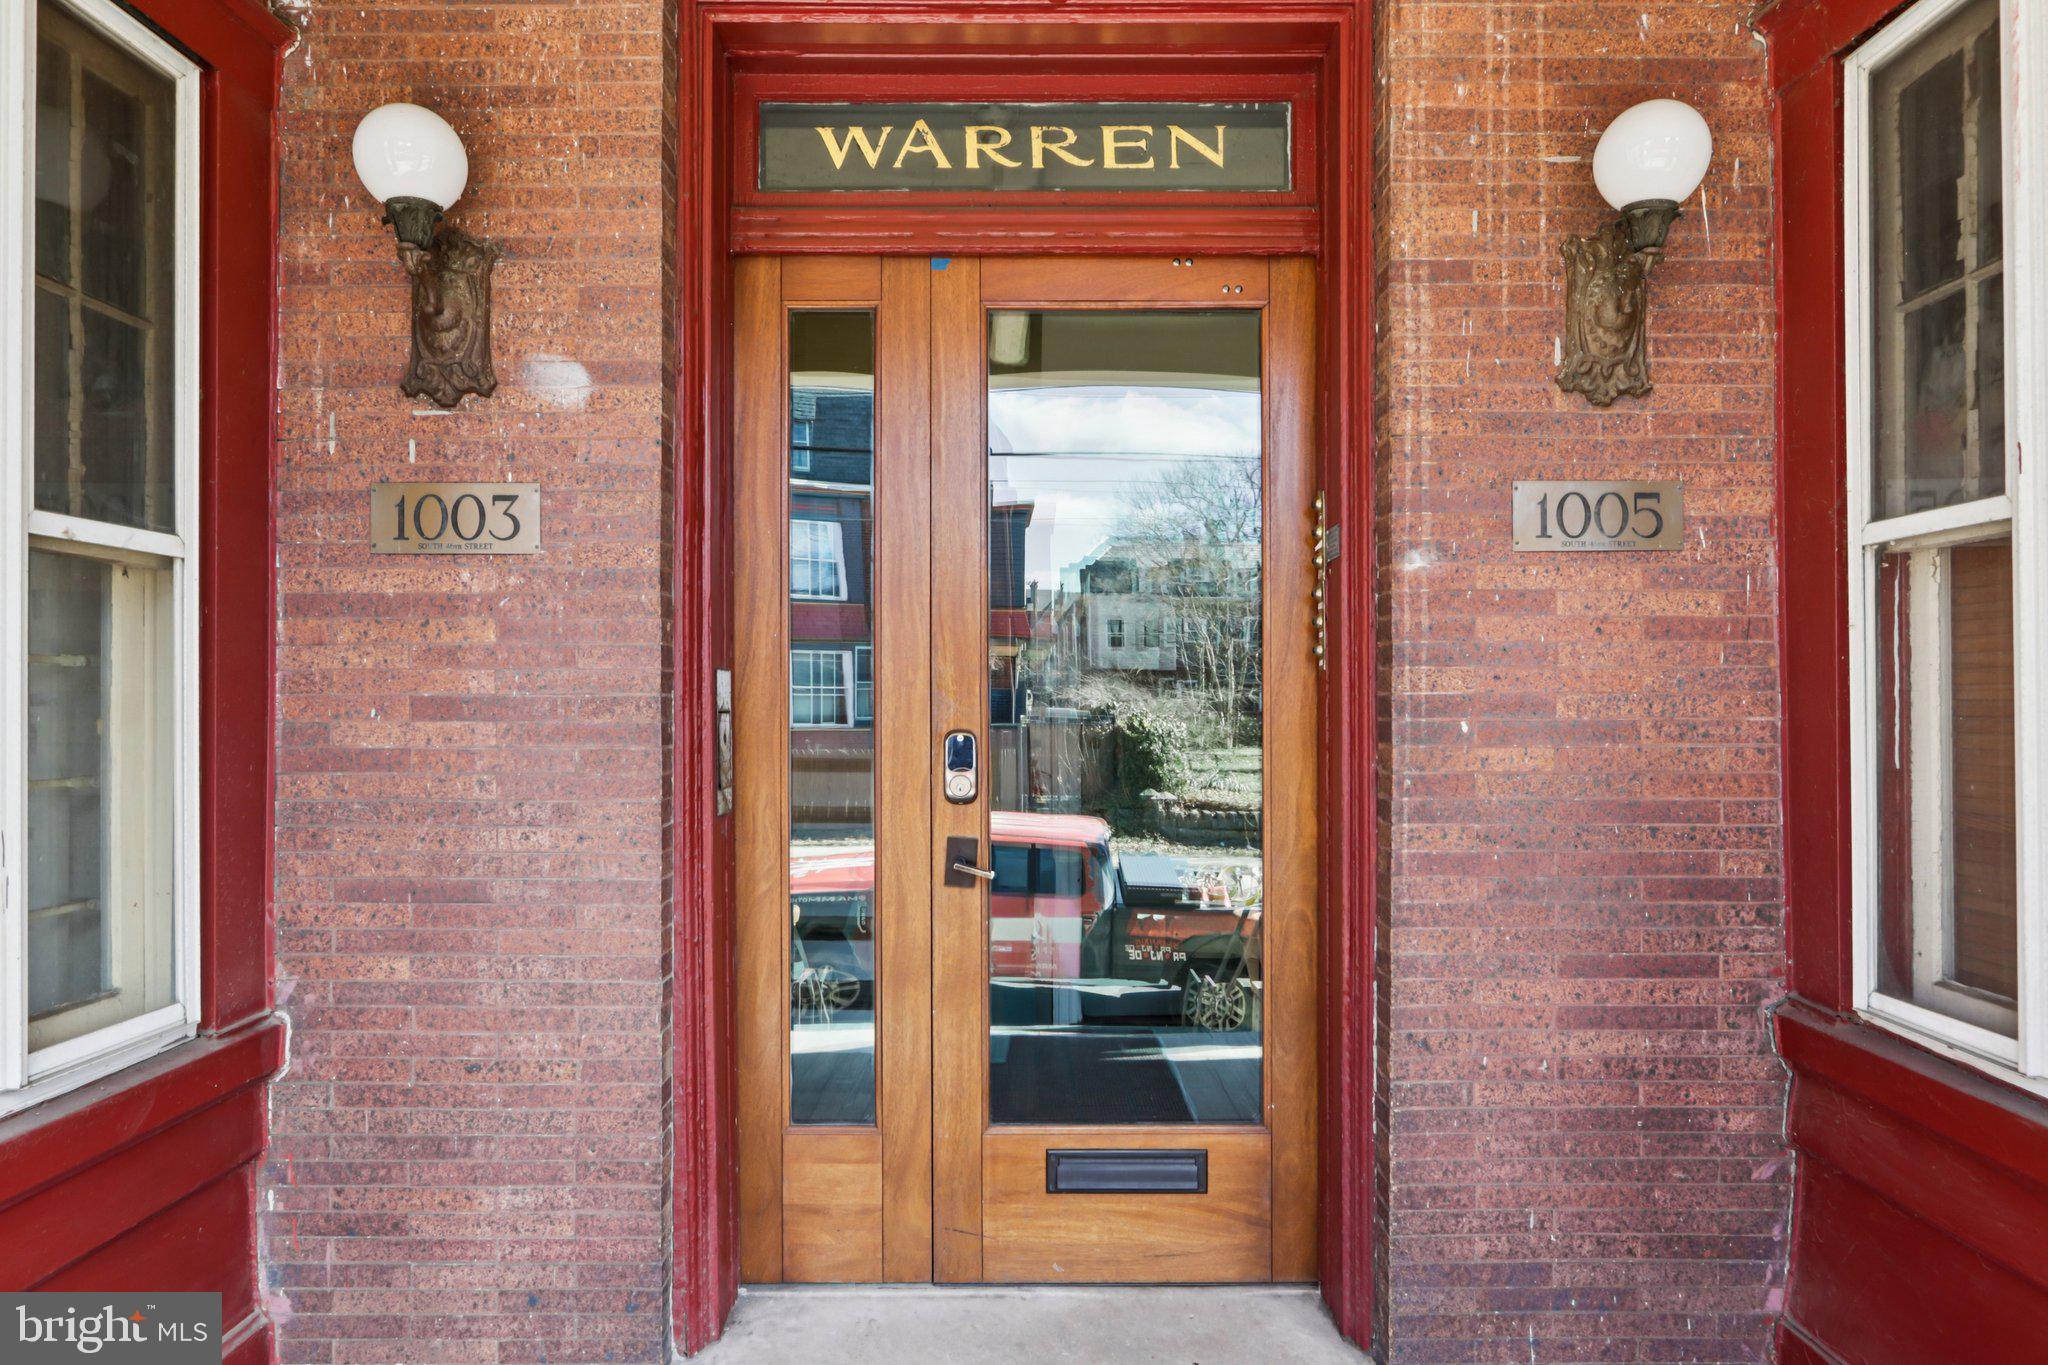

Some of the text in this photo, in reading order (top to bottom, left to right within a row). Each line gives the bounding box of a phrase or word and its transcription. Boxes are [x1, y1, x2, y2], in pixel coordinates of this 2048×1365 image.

[814, 118, 1228, 170] WARREN
[392, 493, 521, 541] 1003
[1535, 491, 1664, 539] 1005
[417, 542, 443, 550] SOUTH
[464, 542, 493, 550] STREET
[1561, 540, 1587, 548] SOUTH
[1608, 540, 1637, 548] STREET
